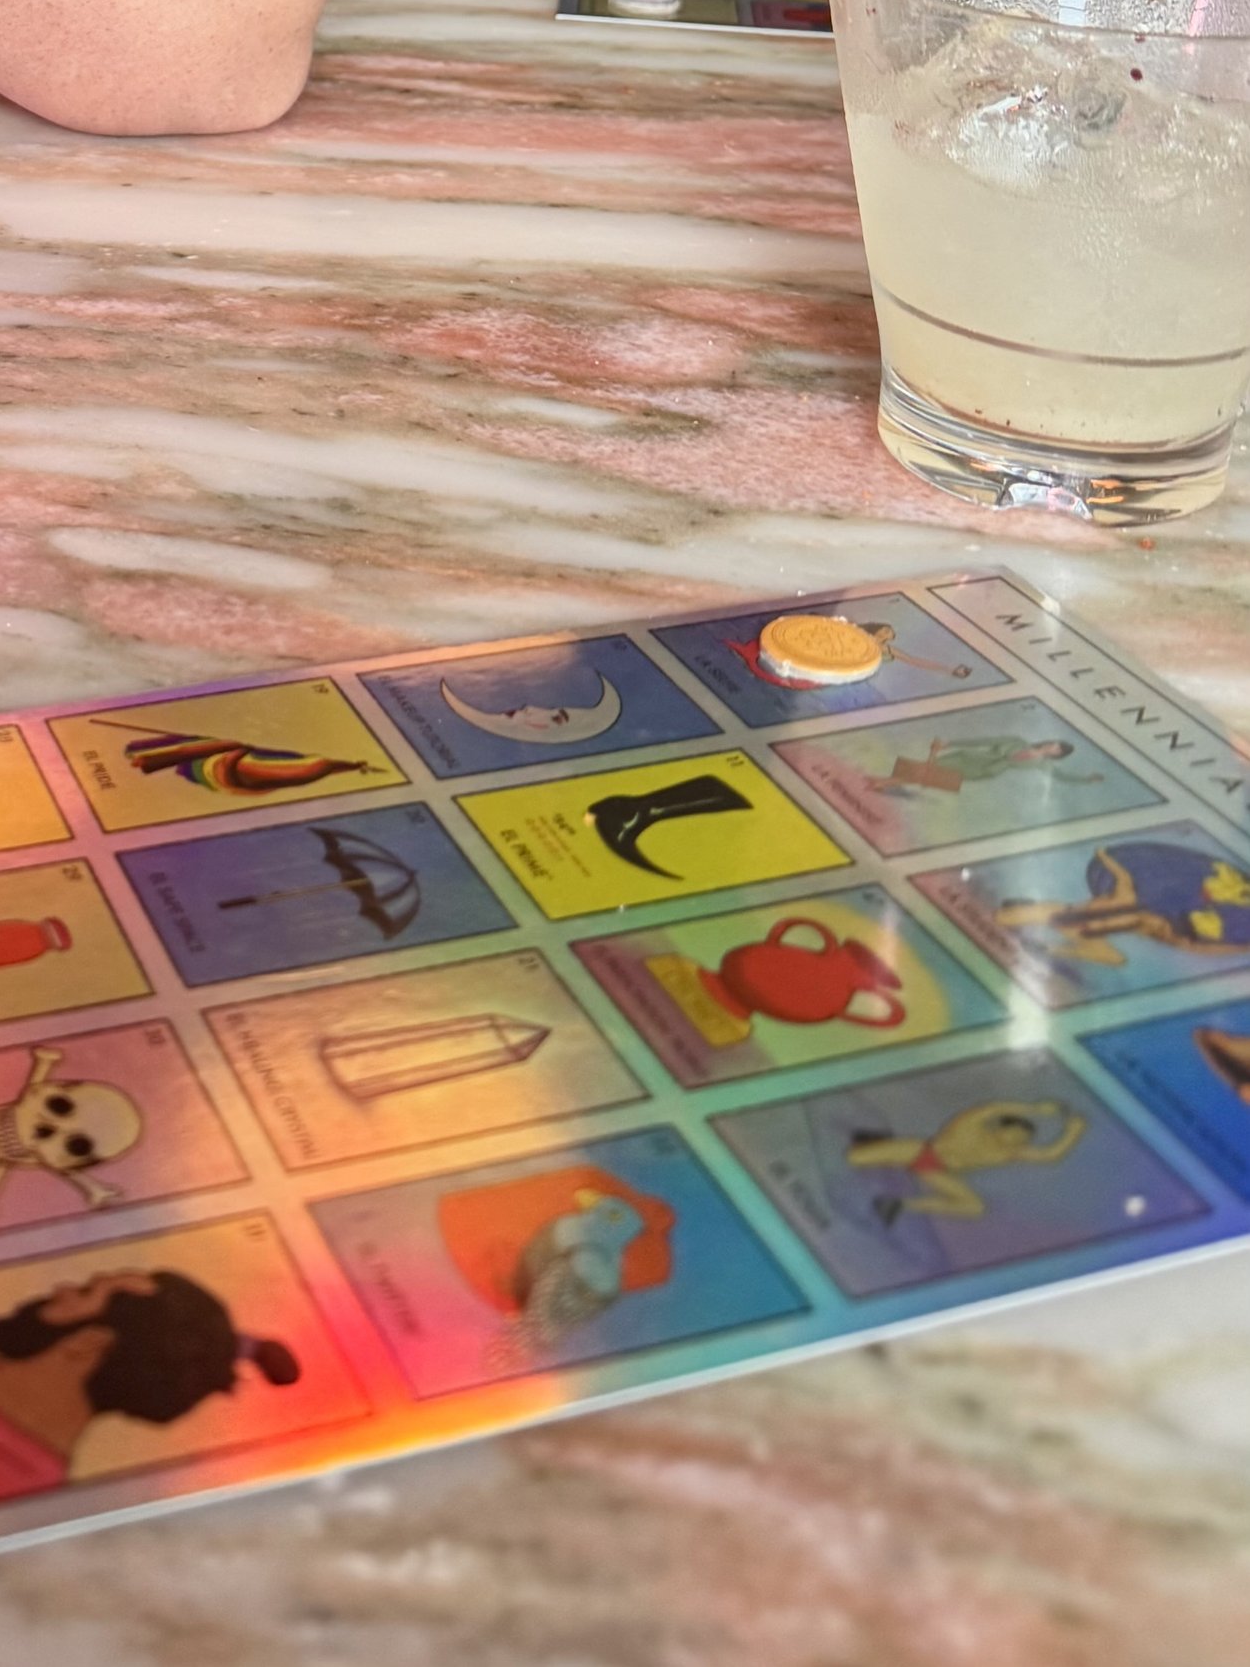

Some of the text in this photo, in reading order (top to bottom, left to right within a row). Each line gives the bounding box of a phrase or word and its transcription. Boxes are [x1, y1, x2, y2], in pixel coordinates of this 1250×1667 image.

[995, 614, 1250, 811] MILLENNIA
[80, 749, 116, 790] EL PRIDE
[498, 829, 521, 842] EL
